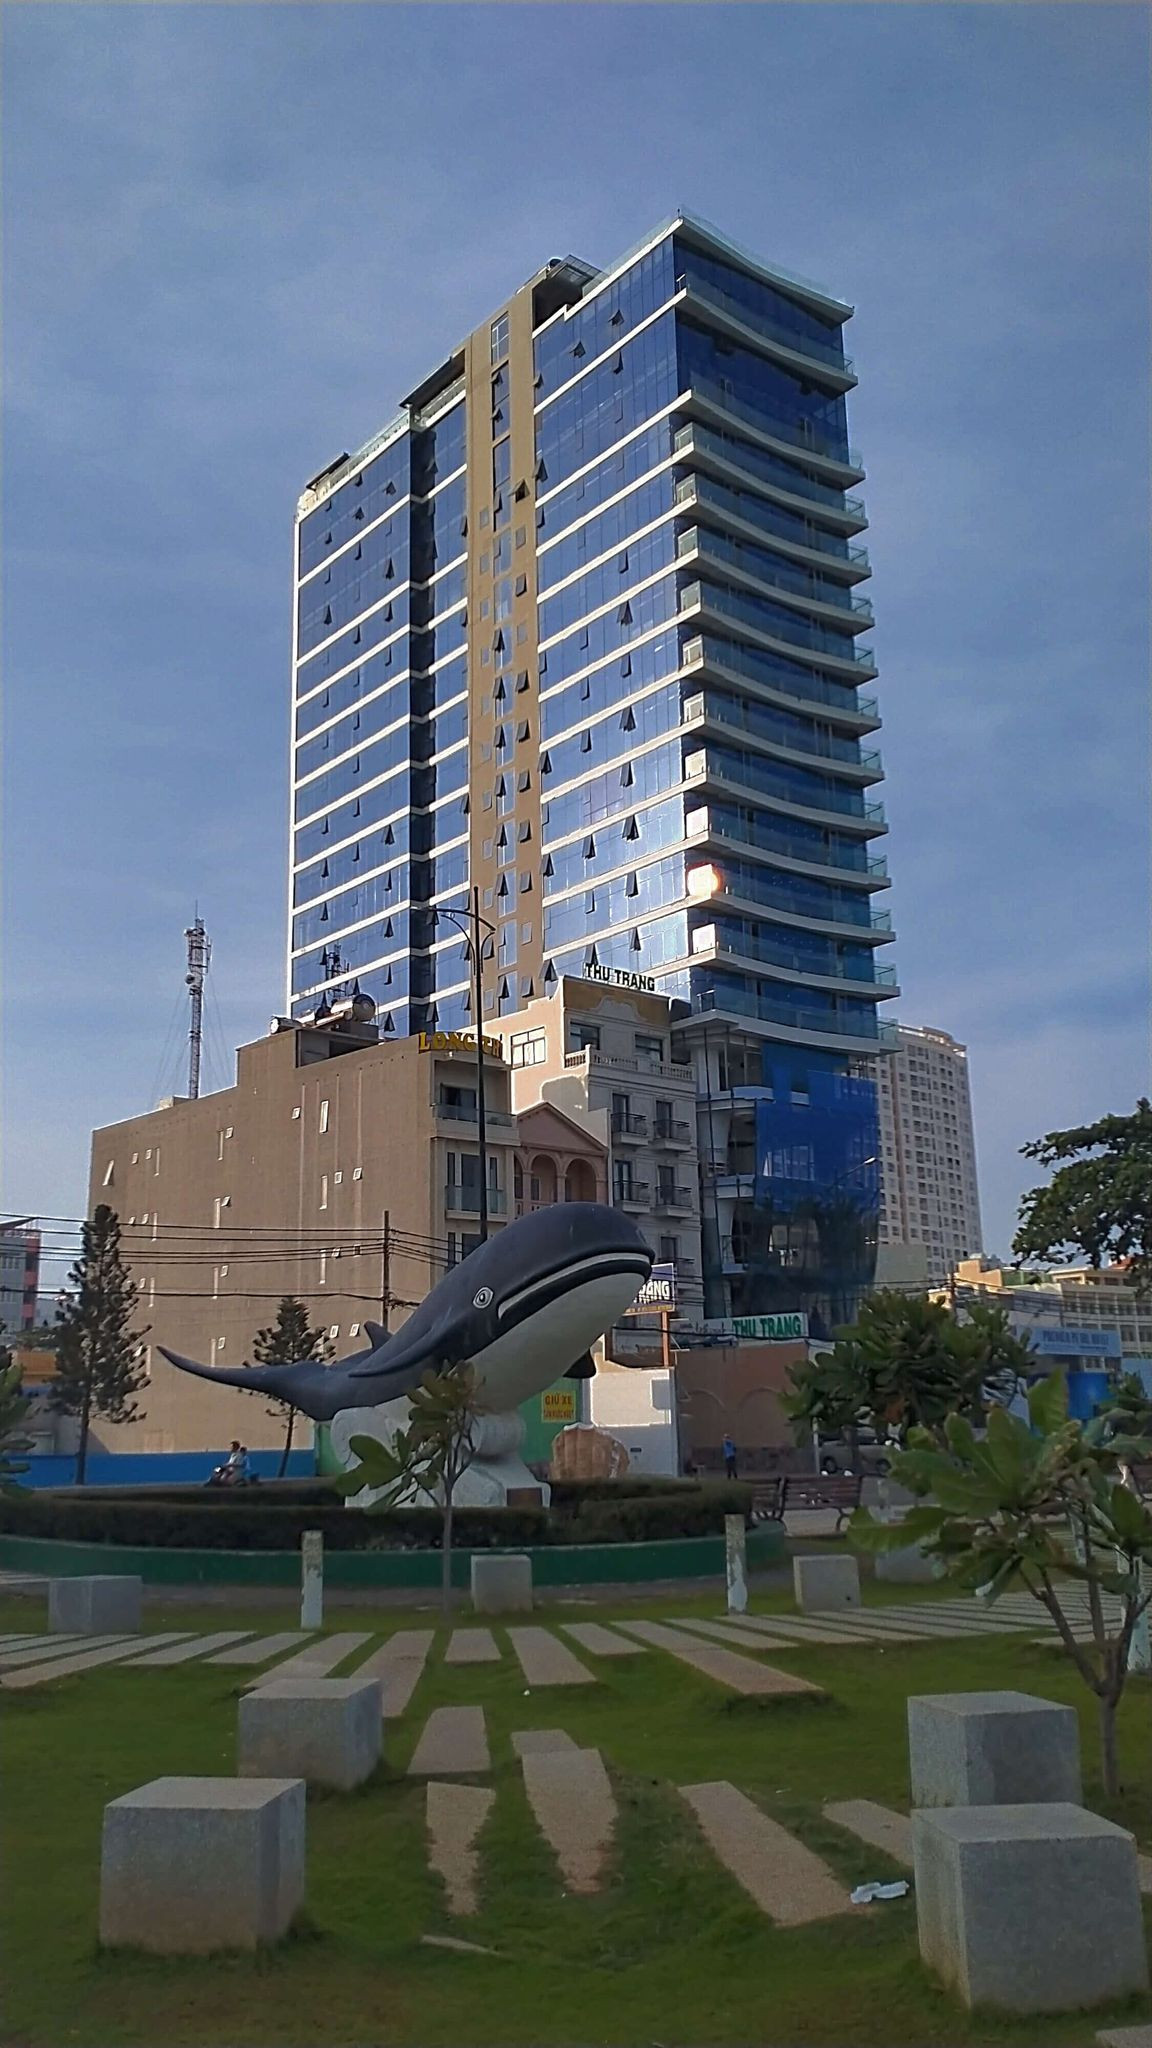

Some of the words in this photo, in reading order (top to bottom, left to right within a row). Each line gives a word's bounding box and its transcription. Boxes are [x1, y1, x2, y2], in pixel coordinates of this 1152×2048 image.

[585, 962, 610, 981] THU
[614, 969, 655, 992] TRANG
[418, 1031, 477, 1054] LONG
[733, 1318, 757, 1337] THU
[760, 1314, 802, 1337] TRANG
